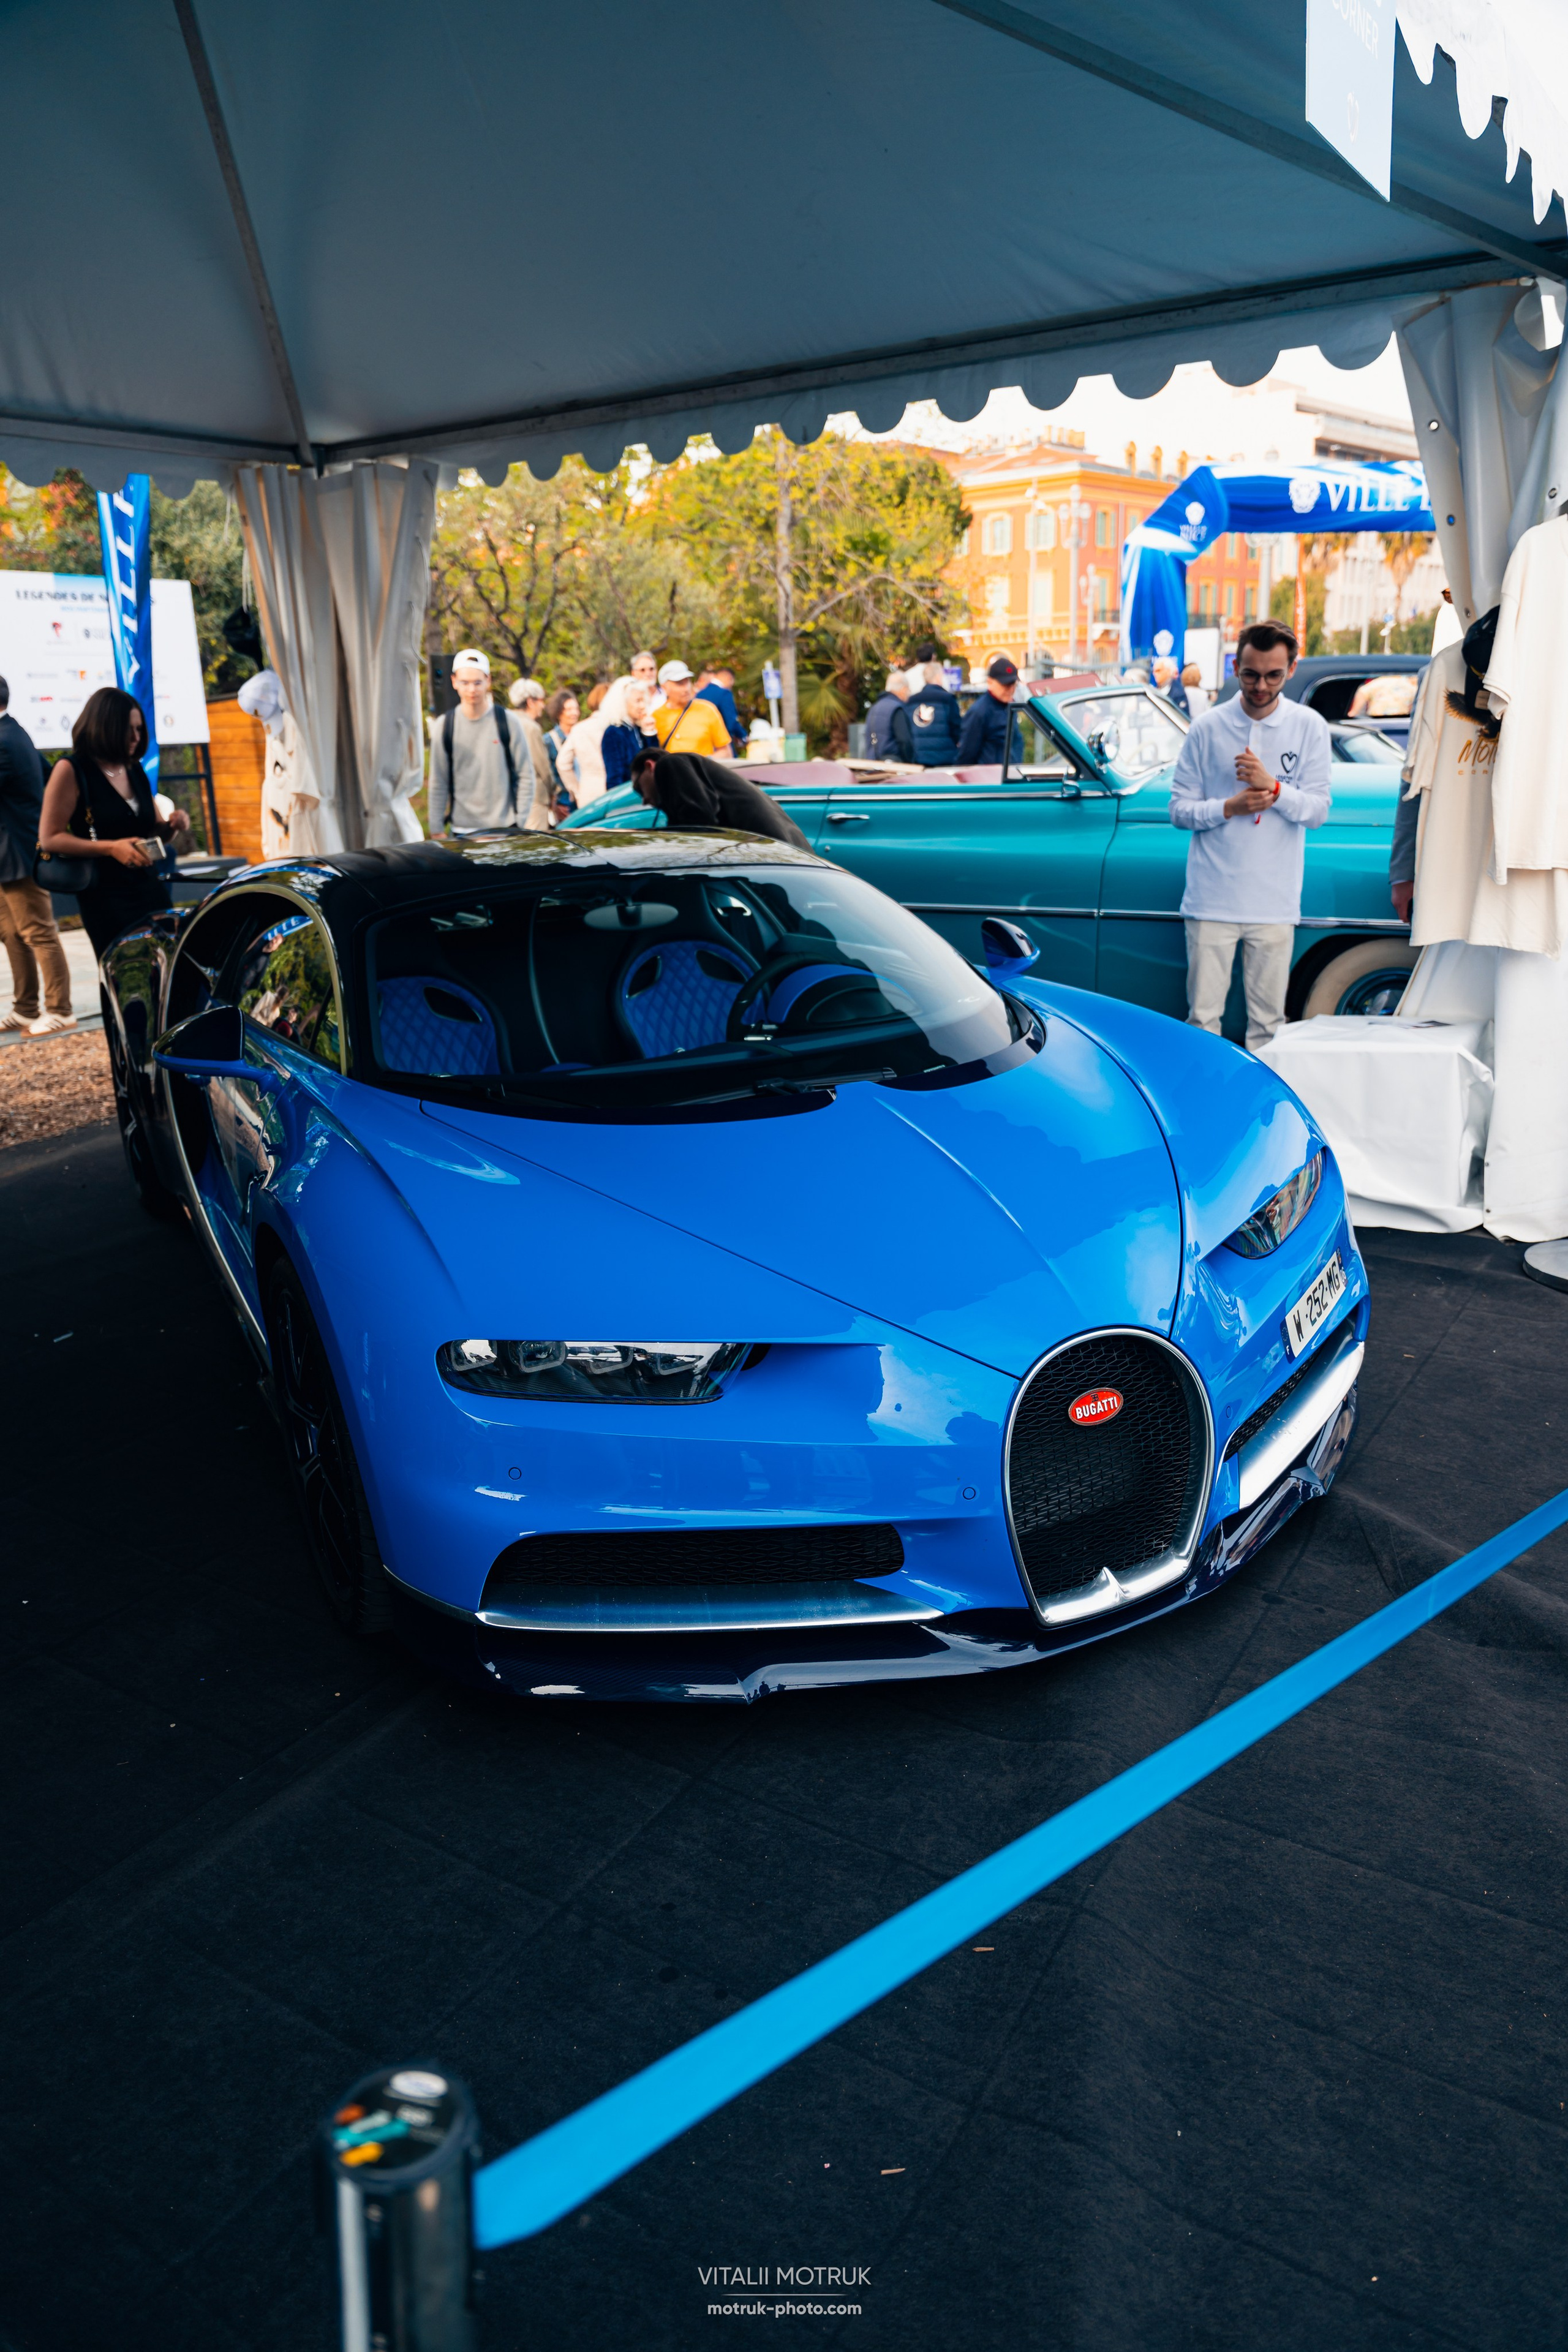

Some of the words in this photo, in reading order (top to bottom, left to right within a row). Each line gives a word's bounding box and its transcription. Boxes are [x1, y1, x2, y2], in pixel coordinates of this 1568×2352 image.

[1332, 0, 1378, 59] ORNER
[1324, 476, 1411, 512] VILLE
[1076, 1396, 1118, 1419] BUGATTI
